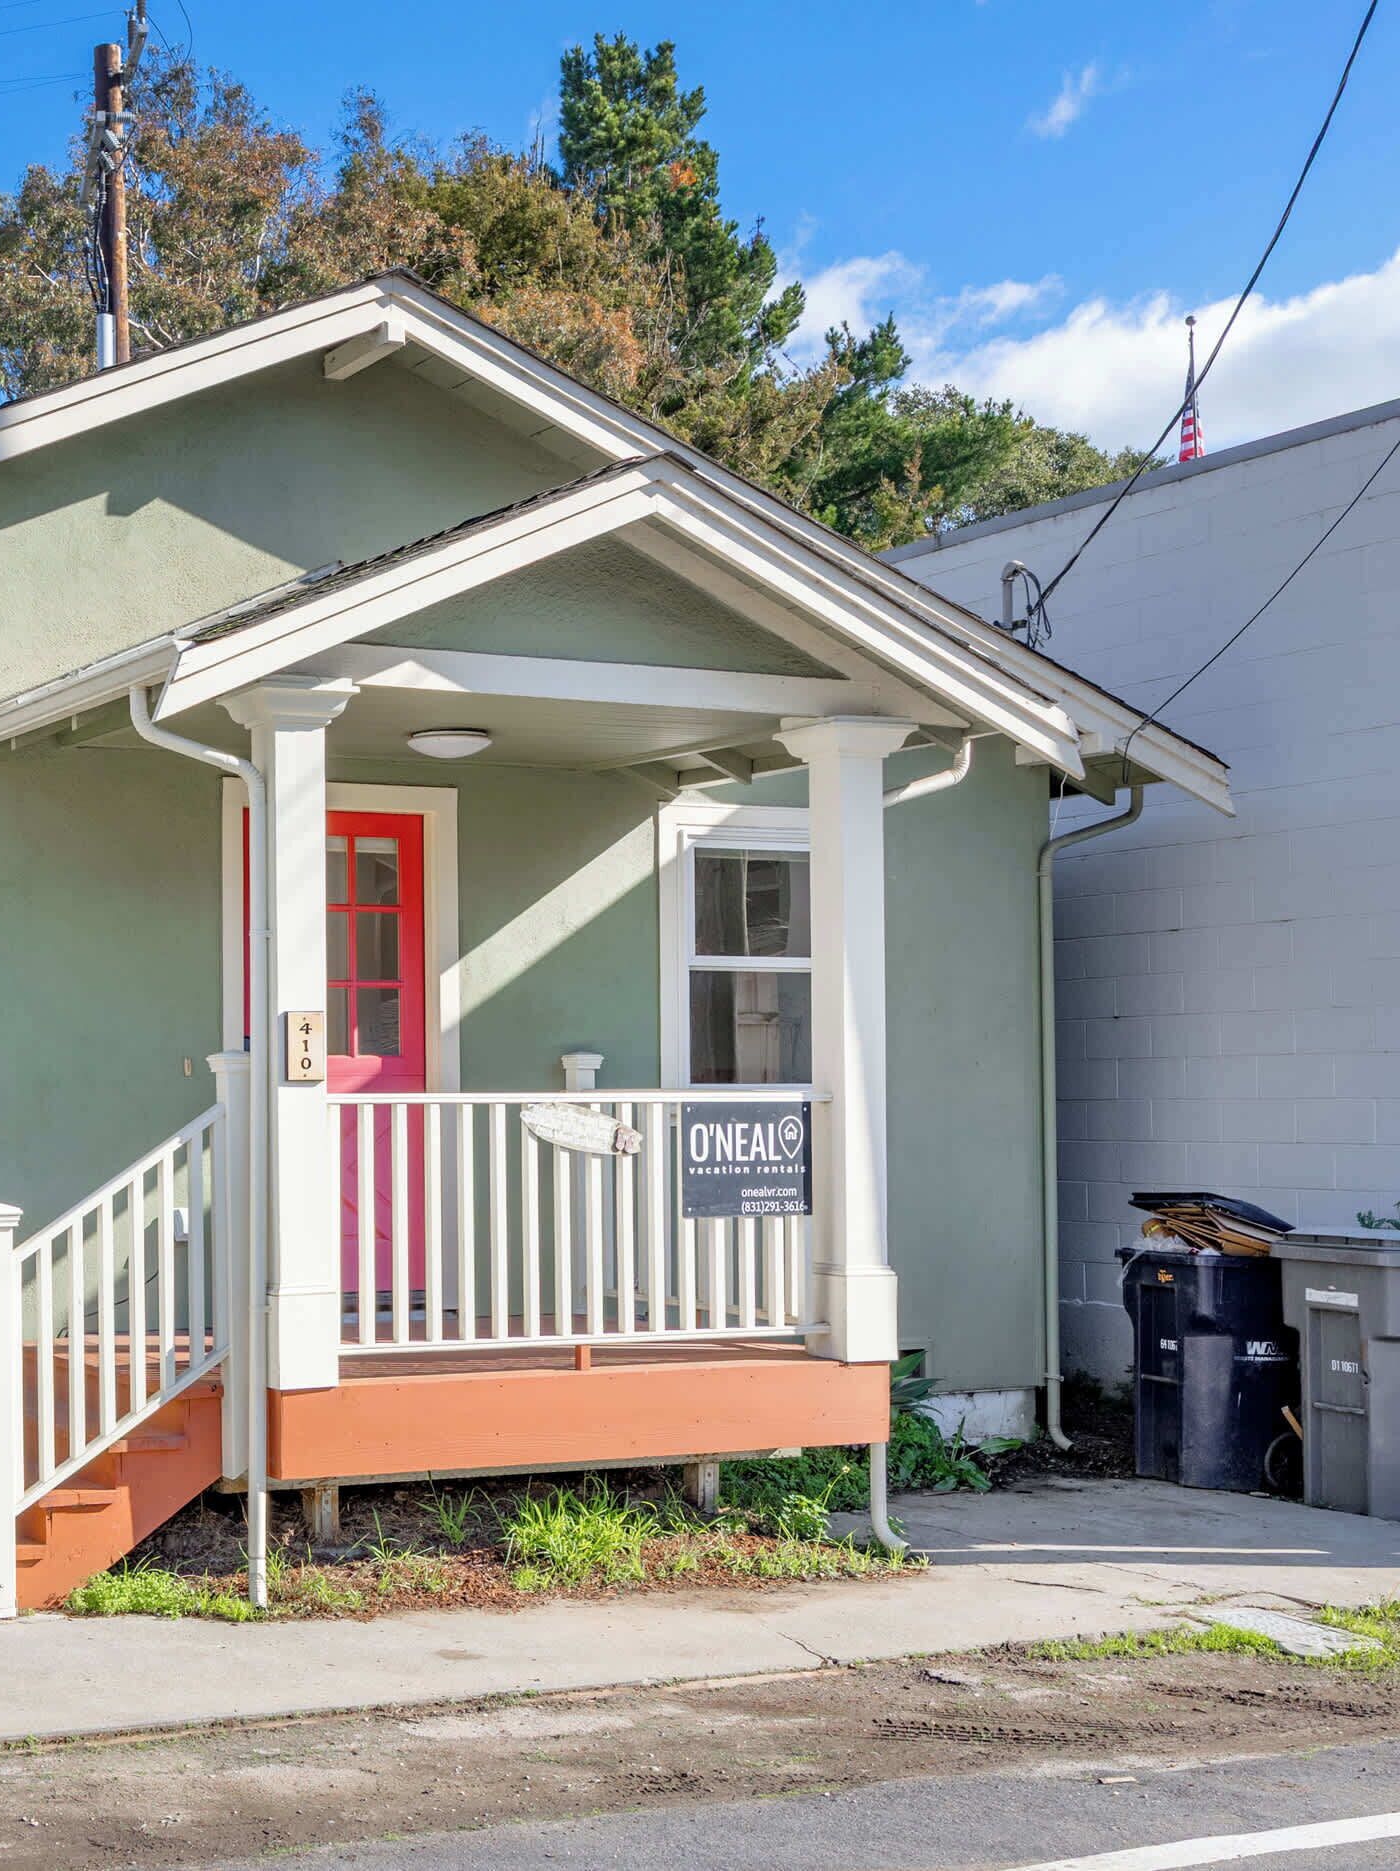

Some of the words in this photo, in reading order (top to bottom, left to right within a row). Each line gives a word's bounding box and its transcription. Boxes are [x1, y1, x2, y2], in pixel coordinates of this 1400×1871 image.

[299, 1022, 313, 1070] 410
[690, 1123, 782, 1162] O'NEAL
[689, 1165, 750, 1175] vacation
[757, 1164, 806, 1174] rentals
[741, 1186, 798, 1198] onealvr.com
